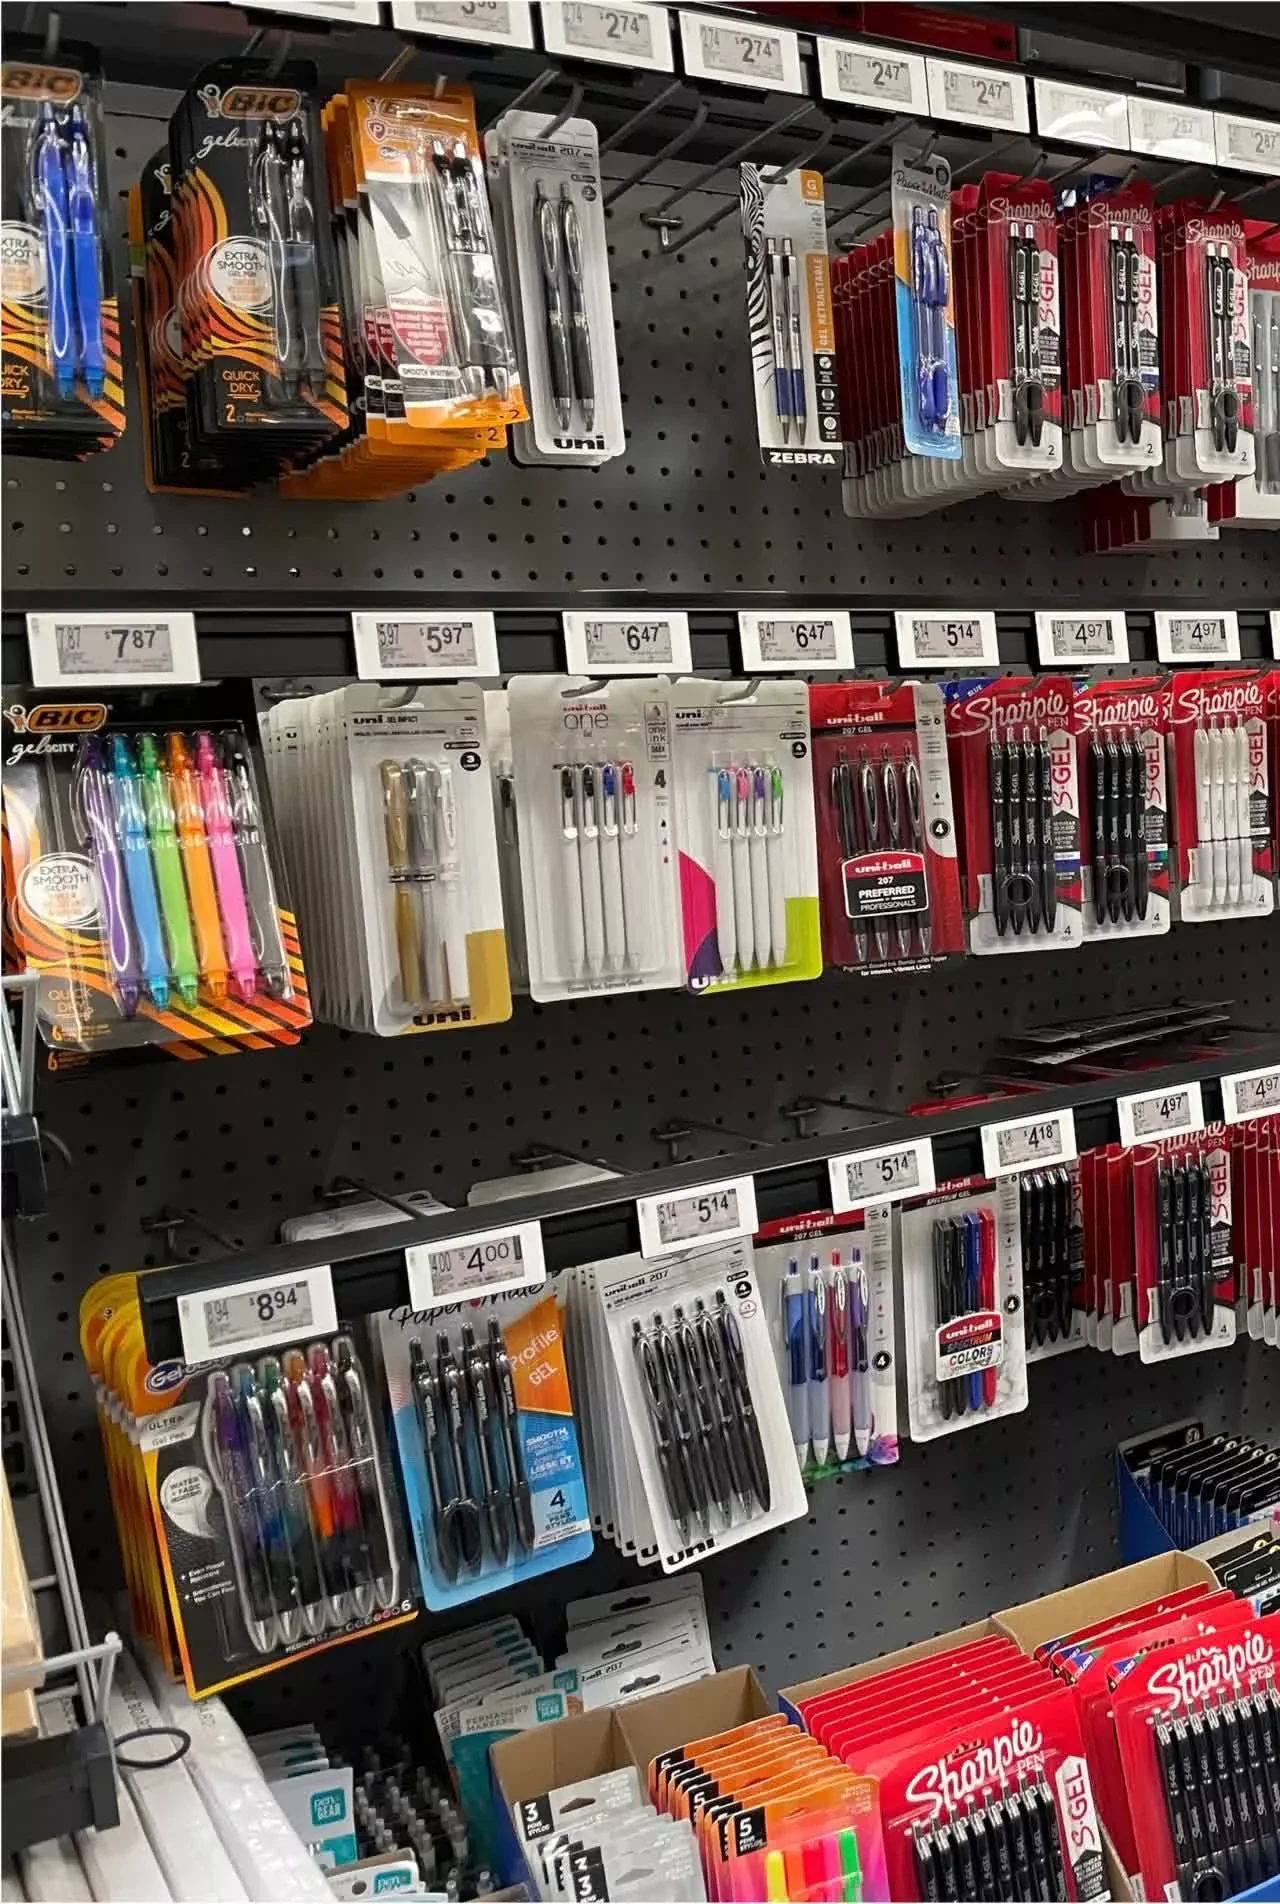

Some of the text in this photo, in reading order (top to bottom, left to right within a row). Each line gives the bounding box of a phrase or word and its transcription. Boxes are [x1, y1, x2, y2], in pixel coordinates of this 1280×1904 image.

[4, 71, 75, 93] BIC
[228, 92, 297, 116] BIC
[989, 196, 1055, 224] Sharpie
[1090, 203, 1153, 228] Sharpie
[1187, 219, 1245, 243] Sharpie
[225, 251, 258, 263] EXTRA
[217, 261, 266, 272] SMOOTH
[814, 258, 829, 346] GEL RETRACTABLE
[222, 371, 260, 381] QUICK
[230, 383, 254, 393] DRY
[225, 404, 236, 422] 2
[554, 436, 605, 450] uni
[1048, 445, 1055, 455] 2
[769, 451, 836, 465] ZEBRA
[1169, 682, 1263, 724] Sharpie
[1245, 706, 1263, 715] PEN
[35, 708, 98, 726] BIC
[353, 715, 383, 725] uni
[675, 711, 701, 719] uni
[964, 689, 1069, 736] Sharpie
[1073, 694, 1159, 735] Sharpie
[564, 711, 609, 730] one
[1048, 716, 1069, 728] PEN
[1140, 717, 1158, 727] PEN
[654, 769, 666, 788] 4
[935, 823, 944, 833] 4
[39, 865, 79, 876] EXTRA
[33, 873, 89, 885] SMOOTH
[878, 876, 894, 885] 207
[858, 885, 916, 899] PREFERRED
[860, 899, 917, 912] PROFESSIONALS
[1064, 925, 1071, 936] 4
[48, 989, 93, 1001] QUICK
[413, 1008, 472, 1026] uni
[1208, 1137, 1226, 1148] PEN
[793, 1229, 824, 1240] 207 GEL
[649, 1270, 669, 1282] 207
[389, 1301, 462, 1328] Paper
[511, 1328, 558, 1371] Profile
[949, 1346, 993, 1366] COLORS
[877, 1356, 885, 1366] 4
[528, 1361, 558, 1386] GEL
[148, 1414, 184, 1431] ULTRA
[169, 1477, 200, 1491] WATER
[551, 1489, 565, 1507] 4
[665, 1538, 715, 1566] uni
[402, 1600, 410, 1611] 6
[1147, 1629, 1273, 1724] Sharpie
[1250, 1662, 1276, 1683] PEN
[1015, 1751, 1045, 1774] PEN
[904, 1718, 1042, 1835] Sharpie
[525, 1802, 538, 1821] 3
[527, 1821, 542, 1831] PENS
[528, 1825, 550, 1836] STYLOS
[740, 1818, 752, 1836] 5
[578, 1876, 592, 1895] 3
